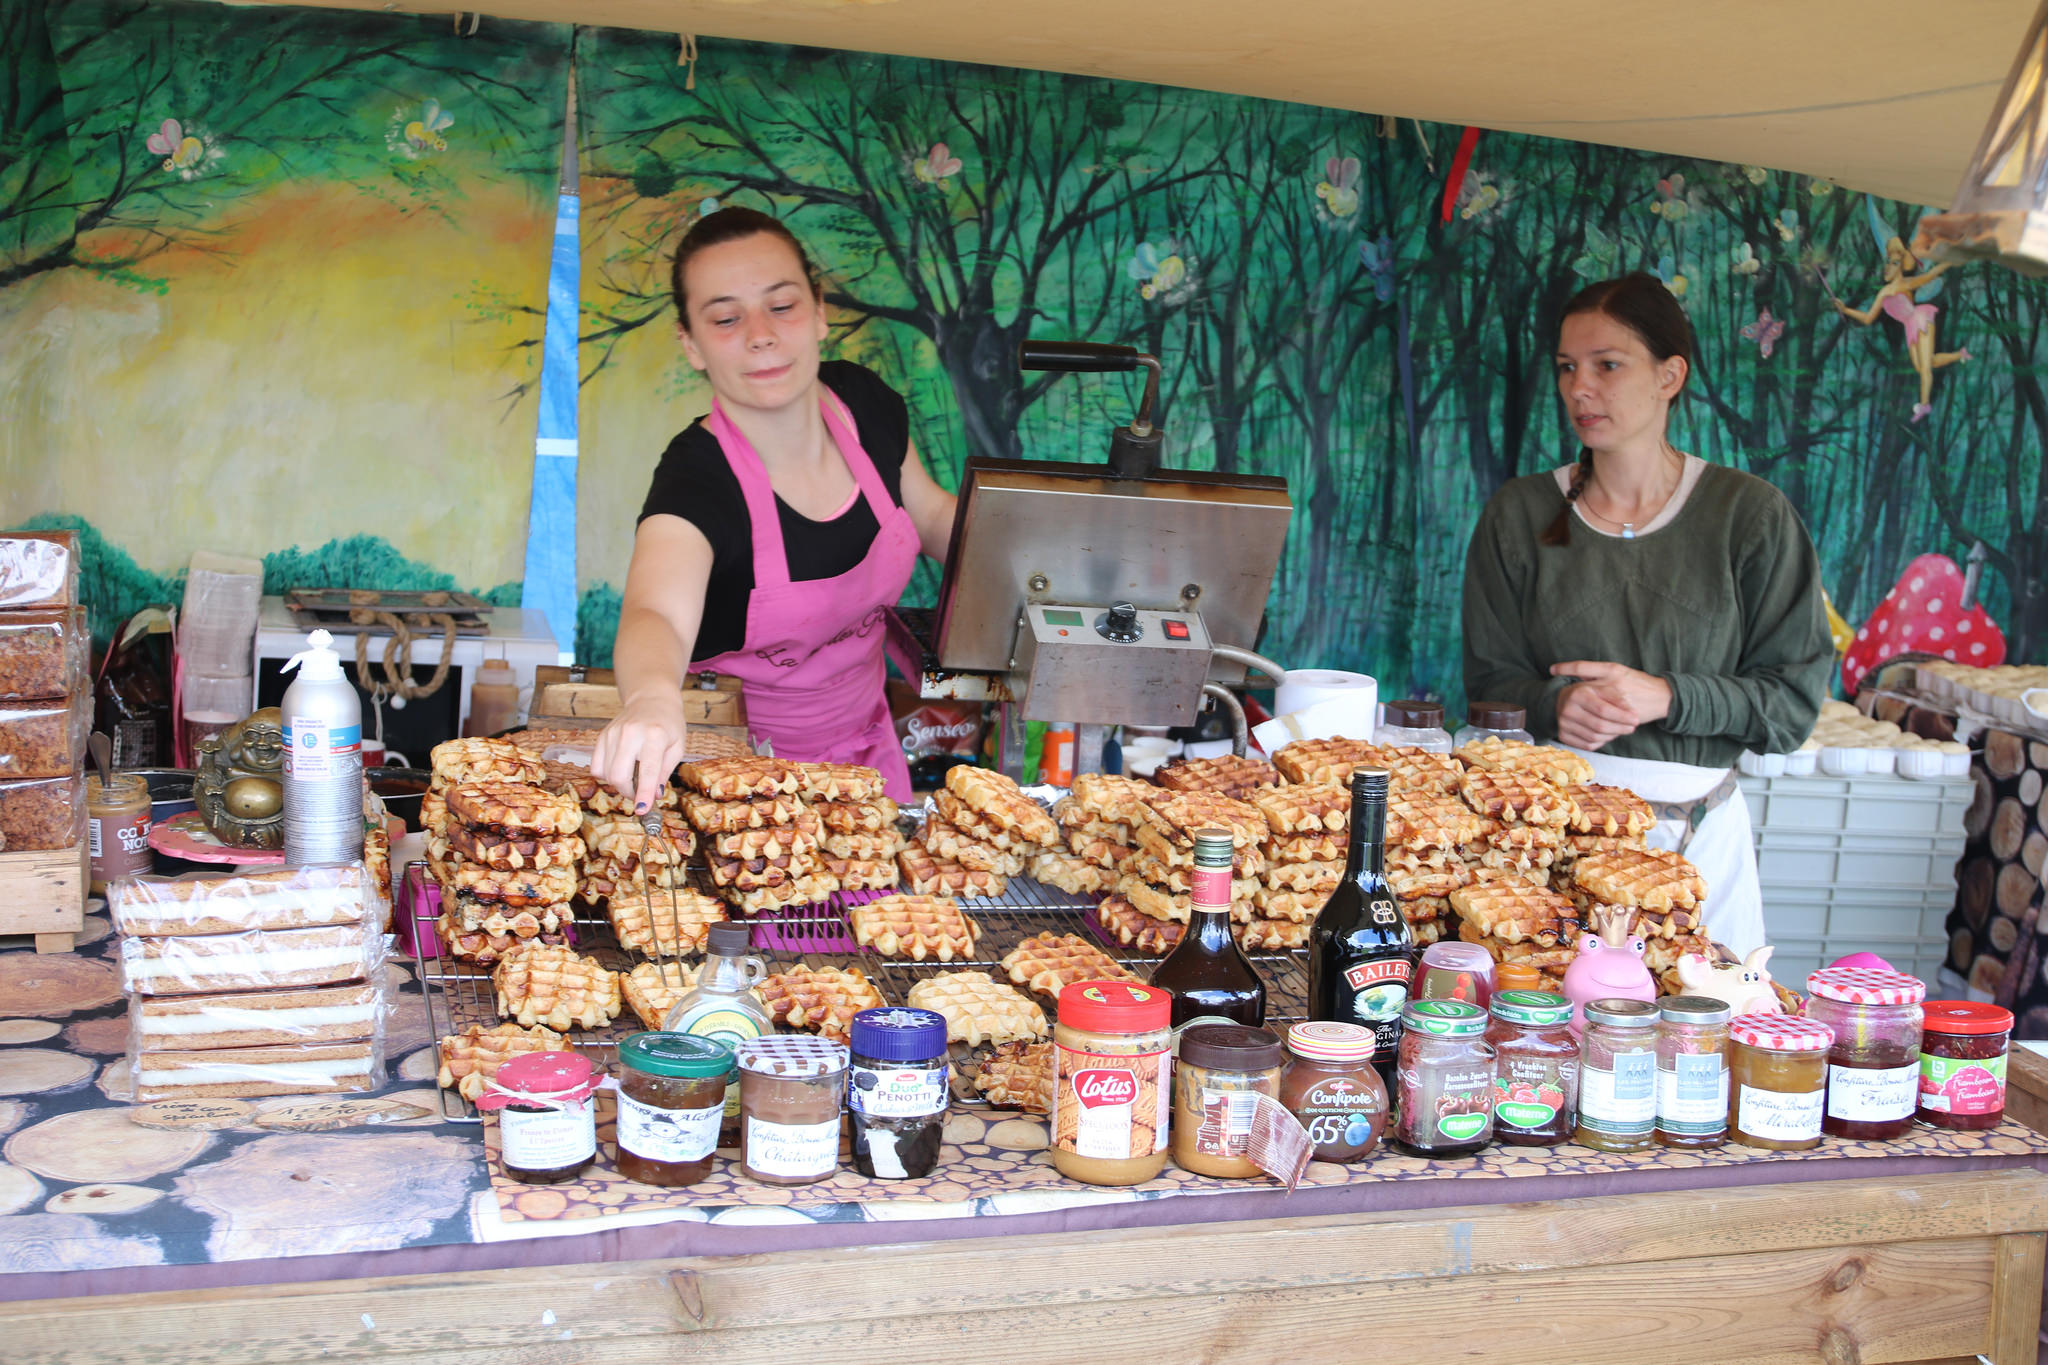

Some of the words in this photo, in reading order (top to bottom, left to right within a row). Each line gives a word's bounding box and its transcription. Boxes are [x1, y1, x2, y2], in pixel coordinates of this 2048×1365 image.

[902, 718, 976, 750] Senseo
[1351, 962, 1411, 985] BAILEYS
[1375, 1024, 1393, 1034] The
[890, 1083, 921, 1093] Duo
[1080, 1073, 1132, 1098] Lotus
[878, 1090, 931, 1102] PENOTTI
[1311, 1088, 1373, 1107] Confipote
[1505, 1107, 1549, 1120] Materne
